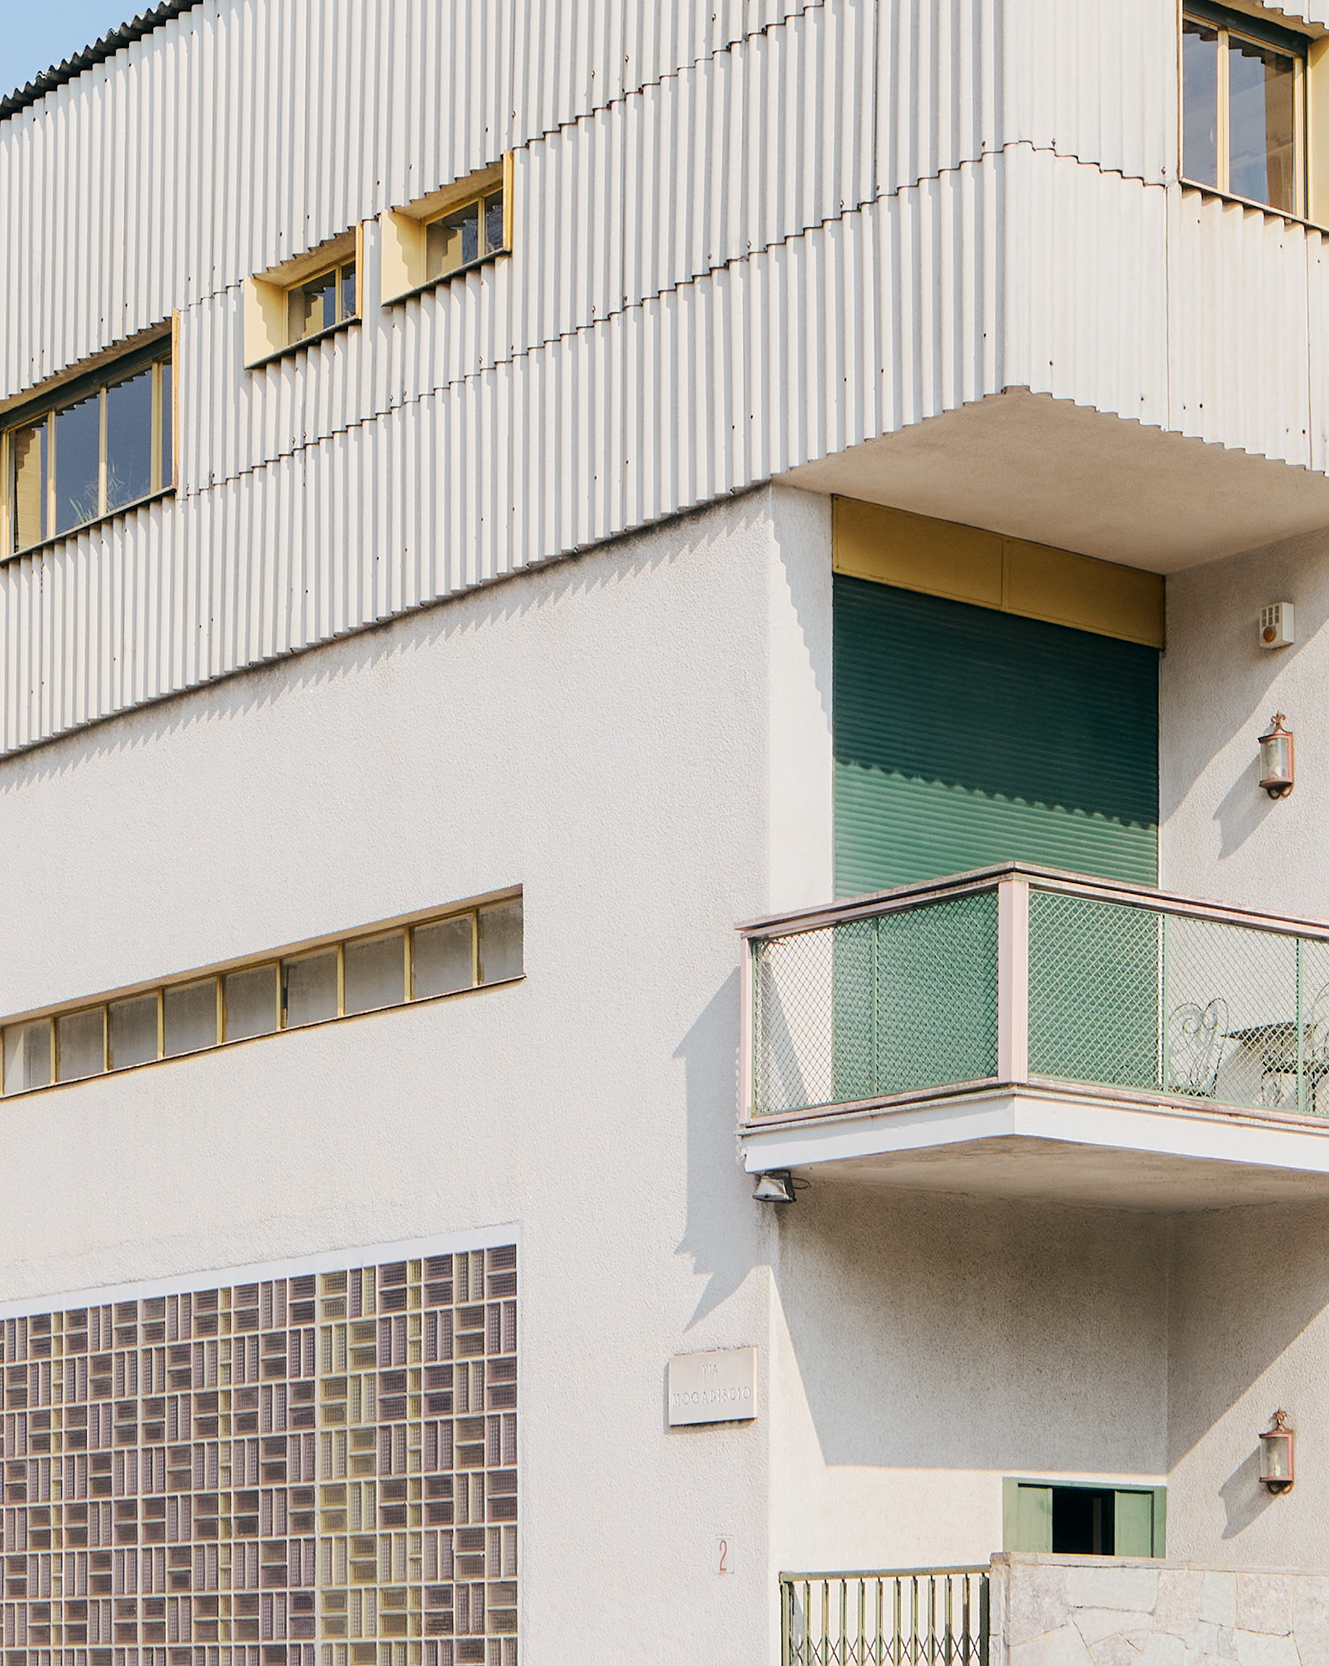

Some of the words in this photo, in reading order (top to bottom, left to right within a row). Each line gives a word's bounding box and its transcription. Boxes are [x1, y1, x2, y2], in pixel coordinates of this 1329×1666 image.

[702, 1363, 718, 1374] VIA
[672, 1386, 751, 1408] MOGADISCIO
[719, 1539, 727, 1572] 2
